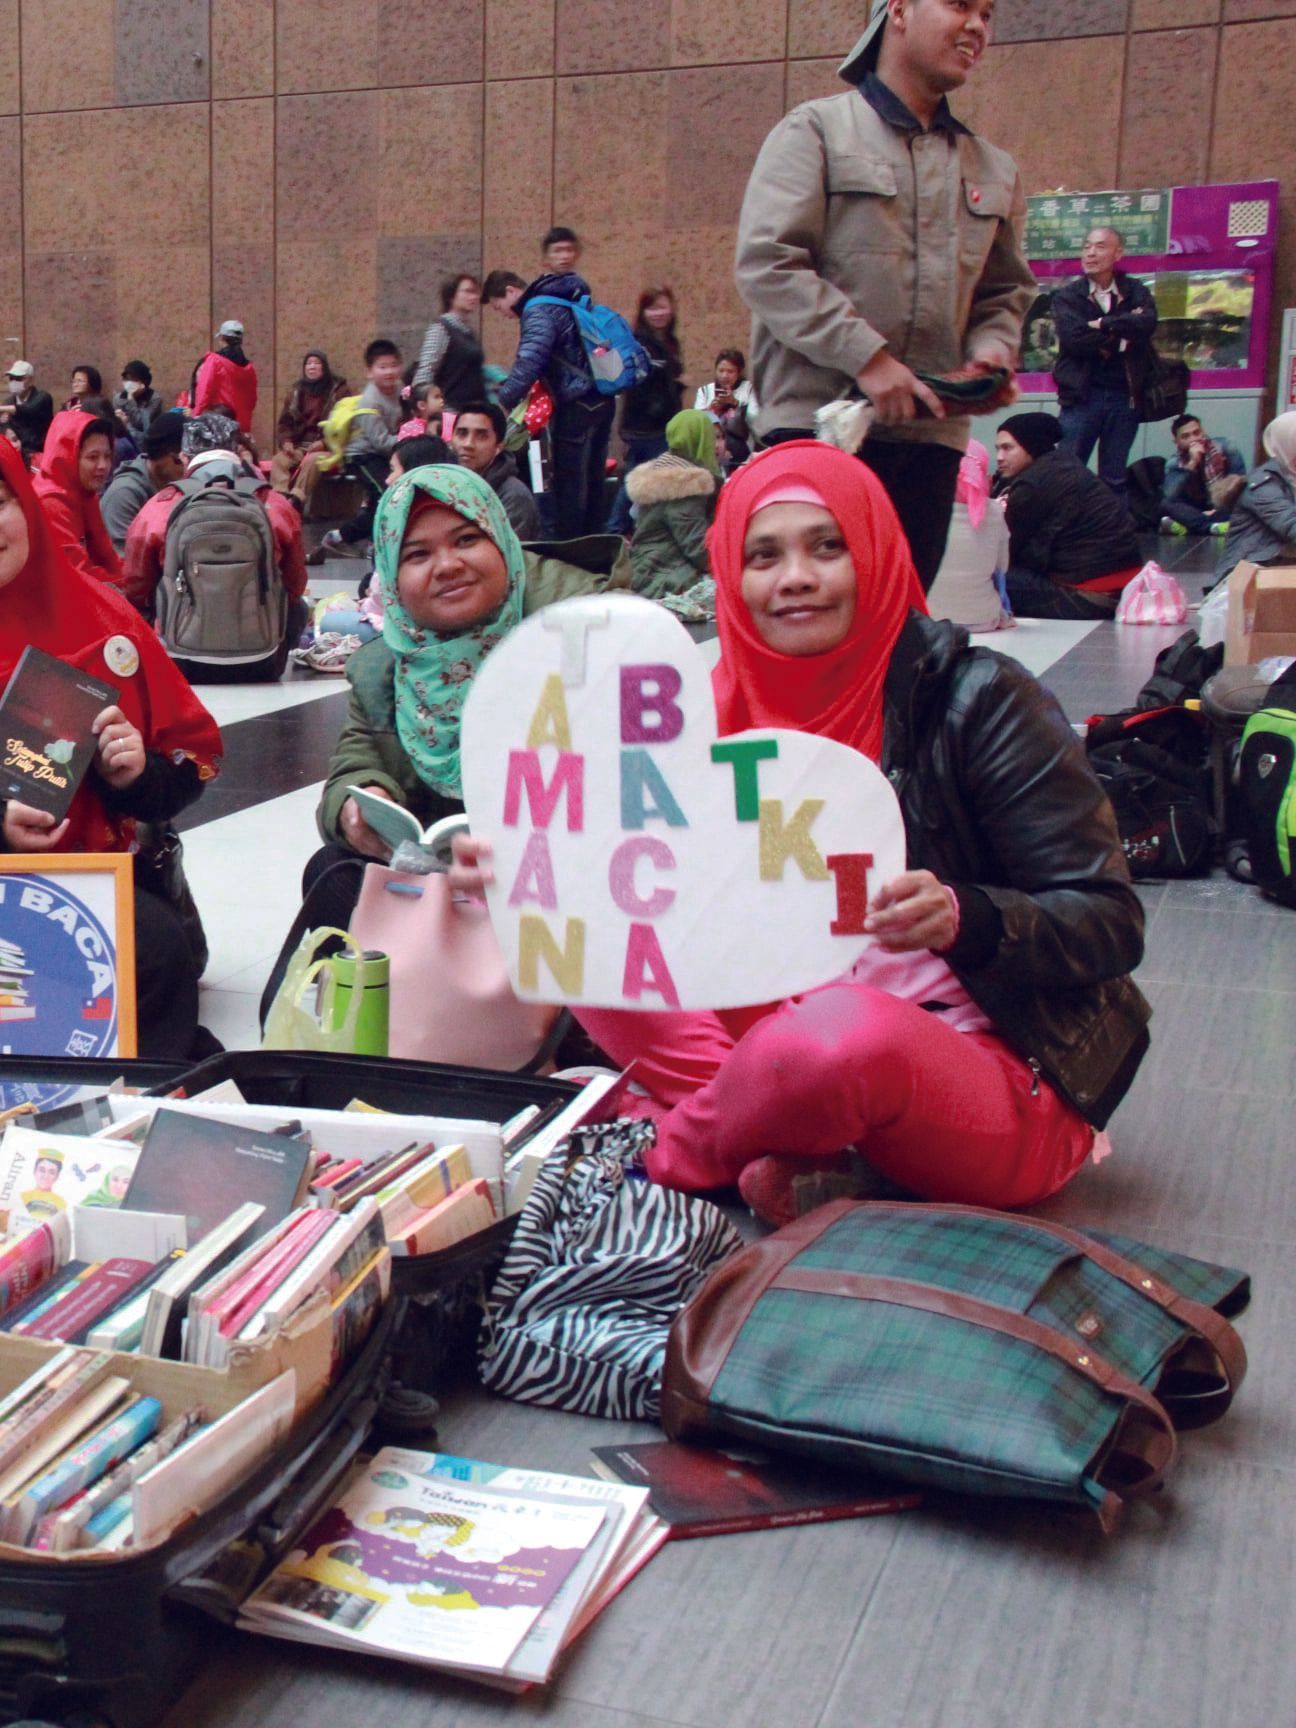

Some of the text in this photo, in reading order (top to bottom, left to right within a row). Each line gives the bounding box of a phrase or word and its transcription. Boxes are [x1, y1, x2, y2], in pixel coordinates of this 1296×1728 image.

[19, 886, 113, 999] BACA
[502, 608, 610, 997] TAMAN
[607, 662, 690, 1008] BACA
